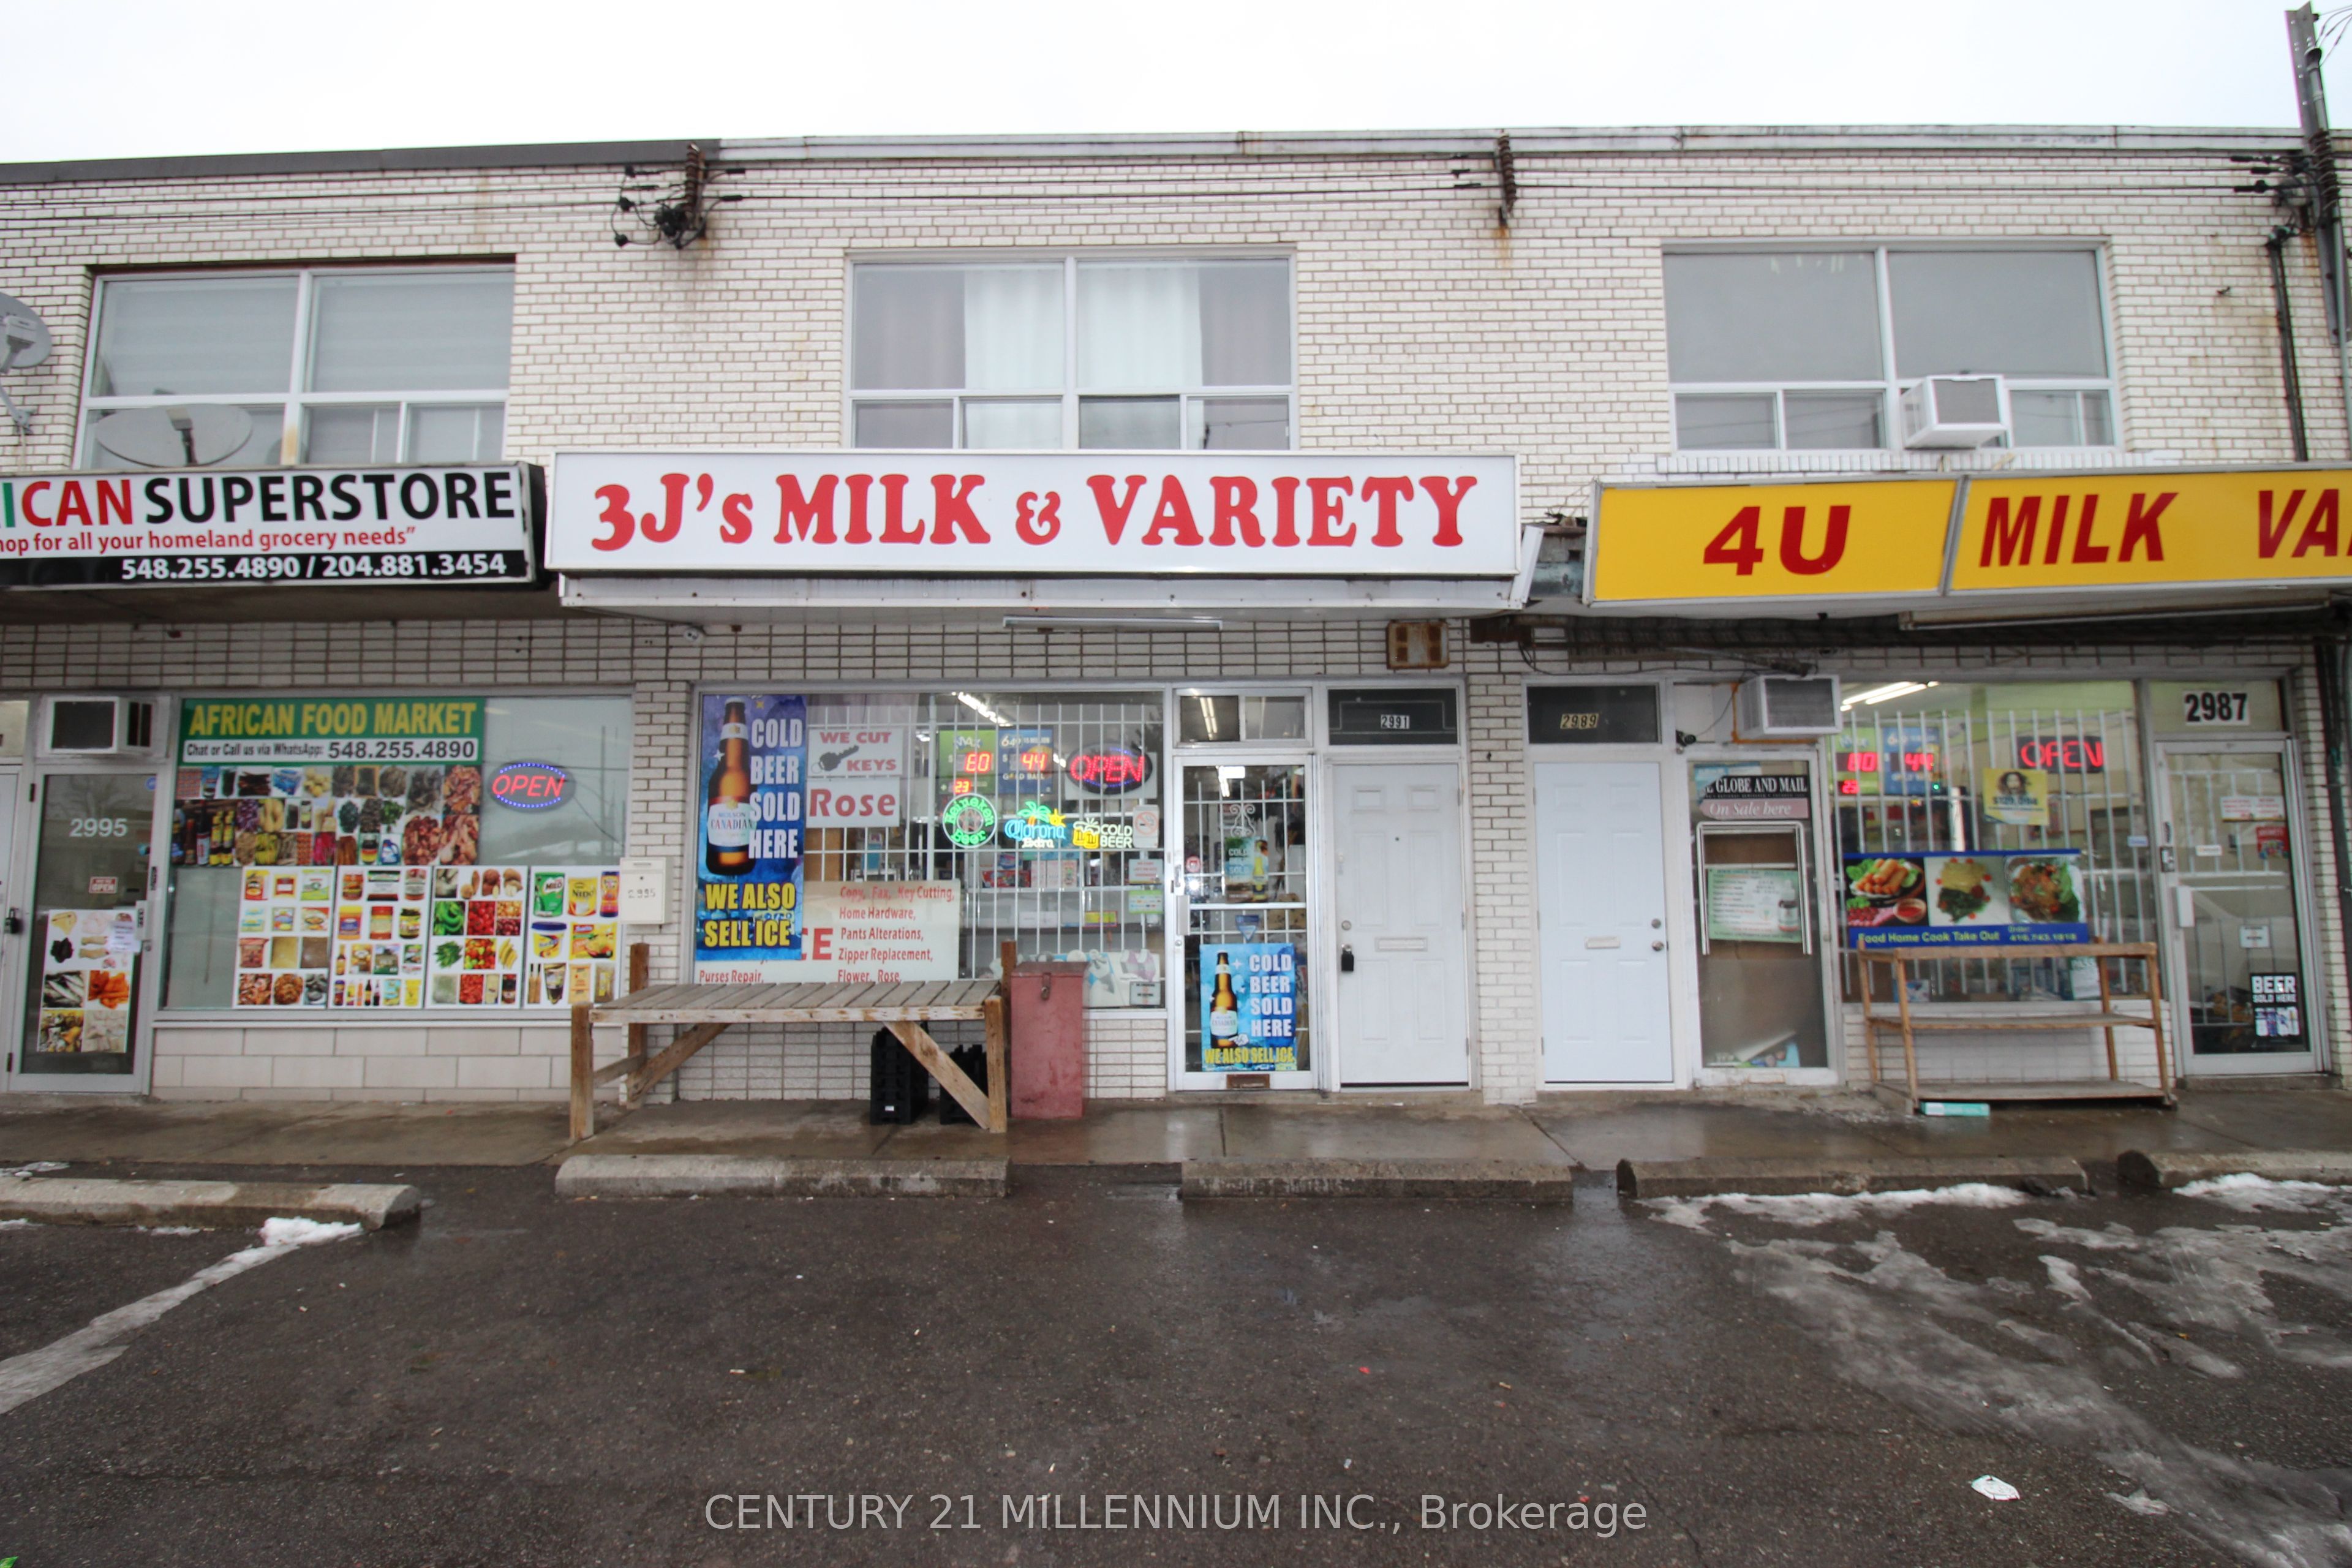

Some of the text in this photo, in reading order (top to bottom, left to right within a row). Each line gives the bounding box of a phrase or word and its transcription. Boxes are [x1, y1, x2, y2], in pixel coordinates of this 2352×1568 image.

[0, 472, 515, 528] ICAN SUPERSTORE
[592, 473, 1477, 551] 3J's MILK & VARIETY
[1703, 488, 2352, 576] 4U MILK VA
[0, 539, 29, 556] op
[34, 532, 62, 551] for
[68, 532, 92, 550] all
[99, 535, 144, 554] your
[149, 529, 254, 548] homeland
[260, 531, 337, 552] grocery
[121, 552, 507, 581] 548.255.4890 / 204.881.3454
[2184, 692, 2247, 722] 2987
[189, 703, 477, 735] AFRICAN FOOD MARKET
[1381, 715, 1409, 729] 2991
[1561, 714, 1598, 729] 2989
[751, 718, 803, 748] COLD
[820, 732, 892, 744] WE CUT
[187, 743, 209, 756] Chat
[211, 746, 221, 755] or
[223, 742, 241, 755] Call
[244, 745, 254, 755] us
[257, 743, 271, 755] via
[328, 741, 475, 759] 548.255.4890
[2021, 740, 2105, 768] OPEN
[750, 756, 799, 785] BEER
[846, 759, 897, 771] KEYS
[1022, 753, 1046, 771] 44
[1069, 755, 1145, 782] OPEN
[492, 774, 565, 797] OPEN
[1716, 777, 1752, 793] GLOBE
[1754, 777, 1777, 793] AND
[1779, 777, 1807, 792] MAIL
[749, 791, 800, 822] SOLD
[809, 788, 897, 818] Rose
[944, 797, 994, 826] Heineken
[1709, 801, 1792, 816] On Sale here
[69, 818, 128, 837] 2995
[710, 819, 753, 829] CANADIAN
[1005, 819, 1066, 842] Corona
[1100, 823, 1133, 836] COLD
[748, 829, 798, 859] HERE
[951, 829, 987, 845] Beer
[1021, 837, 1055, 849] Extra
[1100, 836, 1133, 848] BEER
[705, 883, 796, 910] WE ALSO
[898, 886, 918, 902] Key
[918, 886, 955, 902] Cutting,
[839, 907, 916, 921] Home Hardware,
[704, 920, 791, 947] SELL ICE
[841, 927, 924, 941] Pants Alterations,
[1858, 930, 2000, 944] Food Home Cook Take Out
[838, 947, 933, 965] Zipper Replacement,
[1249, 954, 1292, 972] COLD
[699, 970, 729, 983] Purses
[1250, 976, 1291, 993] BEER
[2251, 975, 2297, 994] BEER
[1250, 997, 1292, 1016] SOLD
[2252, 994, 2274, 1003] SOLD
[1251, 1019, 1292, 1037] HERE
[1205, 1046, 1294, 1064] WE ALSO SELL ICE
